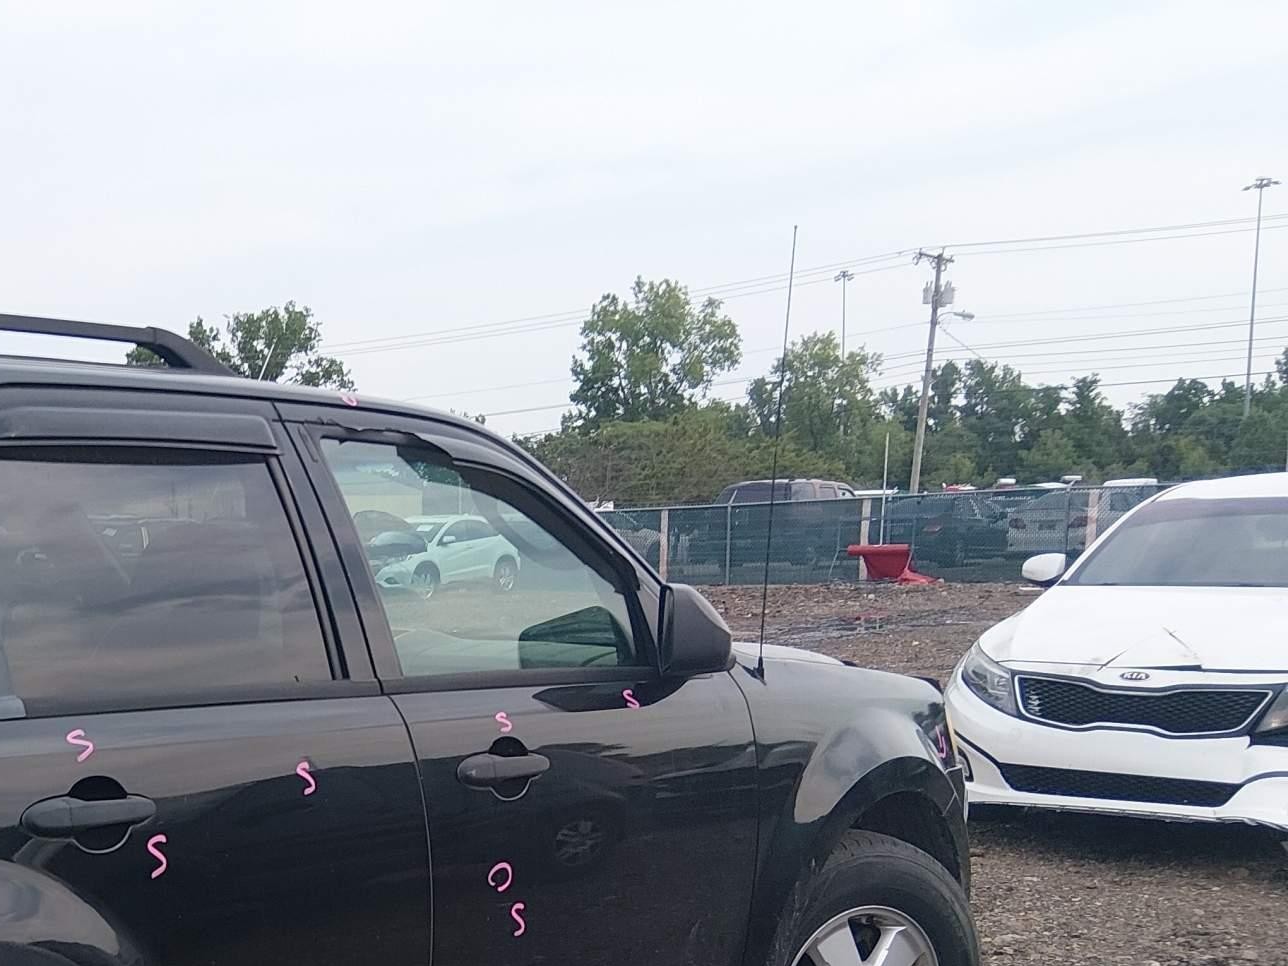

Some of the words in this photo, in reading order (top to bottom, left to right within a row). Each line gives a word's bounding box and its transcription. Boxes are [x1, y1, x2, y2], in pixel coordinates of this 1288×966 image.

[622, 689, 640, 709] S
[495, 711, 513, 733] S
[66, 729, 94, 762] S
[296, 761, 316, 796] S
[147, 834, 167, 880] S
[511, 902, 525, 936] S
